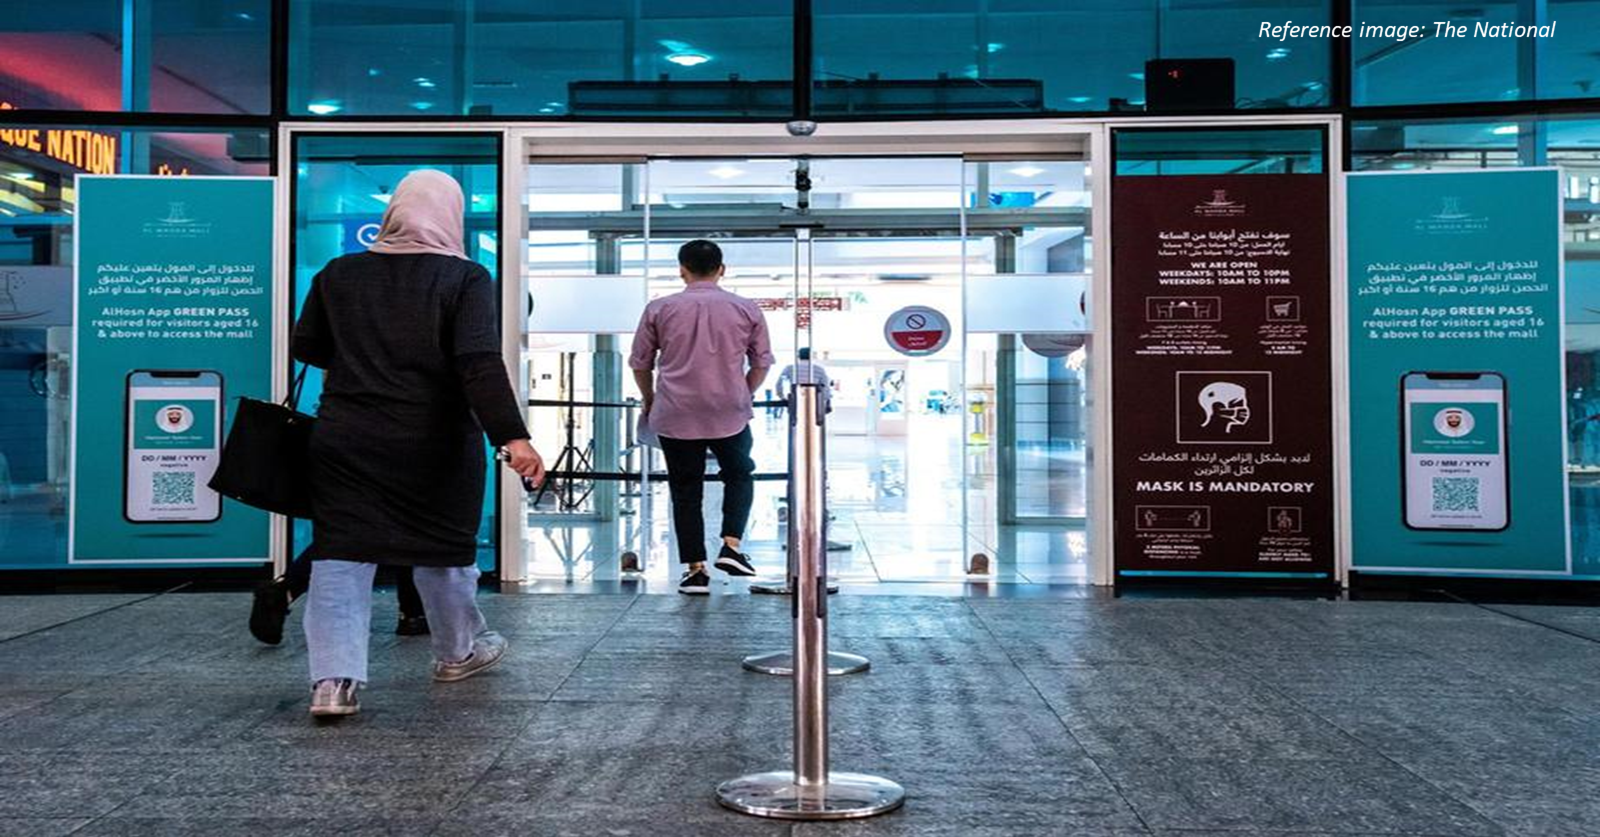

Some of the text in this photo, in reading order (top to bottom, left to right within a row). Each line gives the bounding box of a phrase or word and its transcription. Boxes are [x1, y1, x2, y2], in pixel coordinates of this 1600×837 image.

[47, 129, 116, 175] NATION
[101, 307, 249, 318] AlHosn App GREEN PASS
[1373, 306, 1533, 317] AlHosn App GREEN PASS
[91, 319, 259, 329] required for visitors aged 16
[1363, 318, 1545, 329] required for visitors aged 16
[97, 329, 253, 338] & above to access the mall
[1369, 330, 1538, 338] & above to access the mall
[1138, 452, 1189, 462] الكمامات
[1191, 453, 1217, 463] ارتداء
[1219, 453, 1253, 464] إلزامي
[1255, 453, 1287, 464] بشكل
[1194, 465, 1255, 476] لكل الزائرين
[1136, 481, 1315, 493] MASK IS MANDATORY
